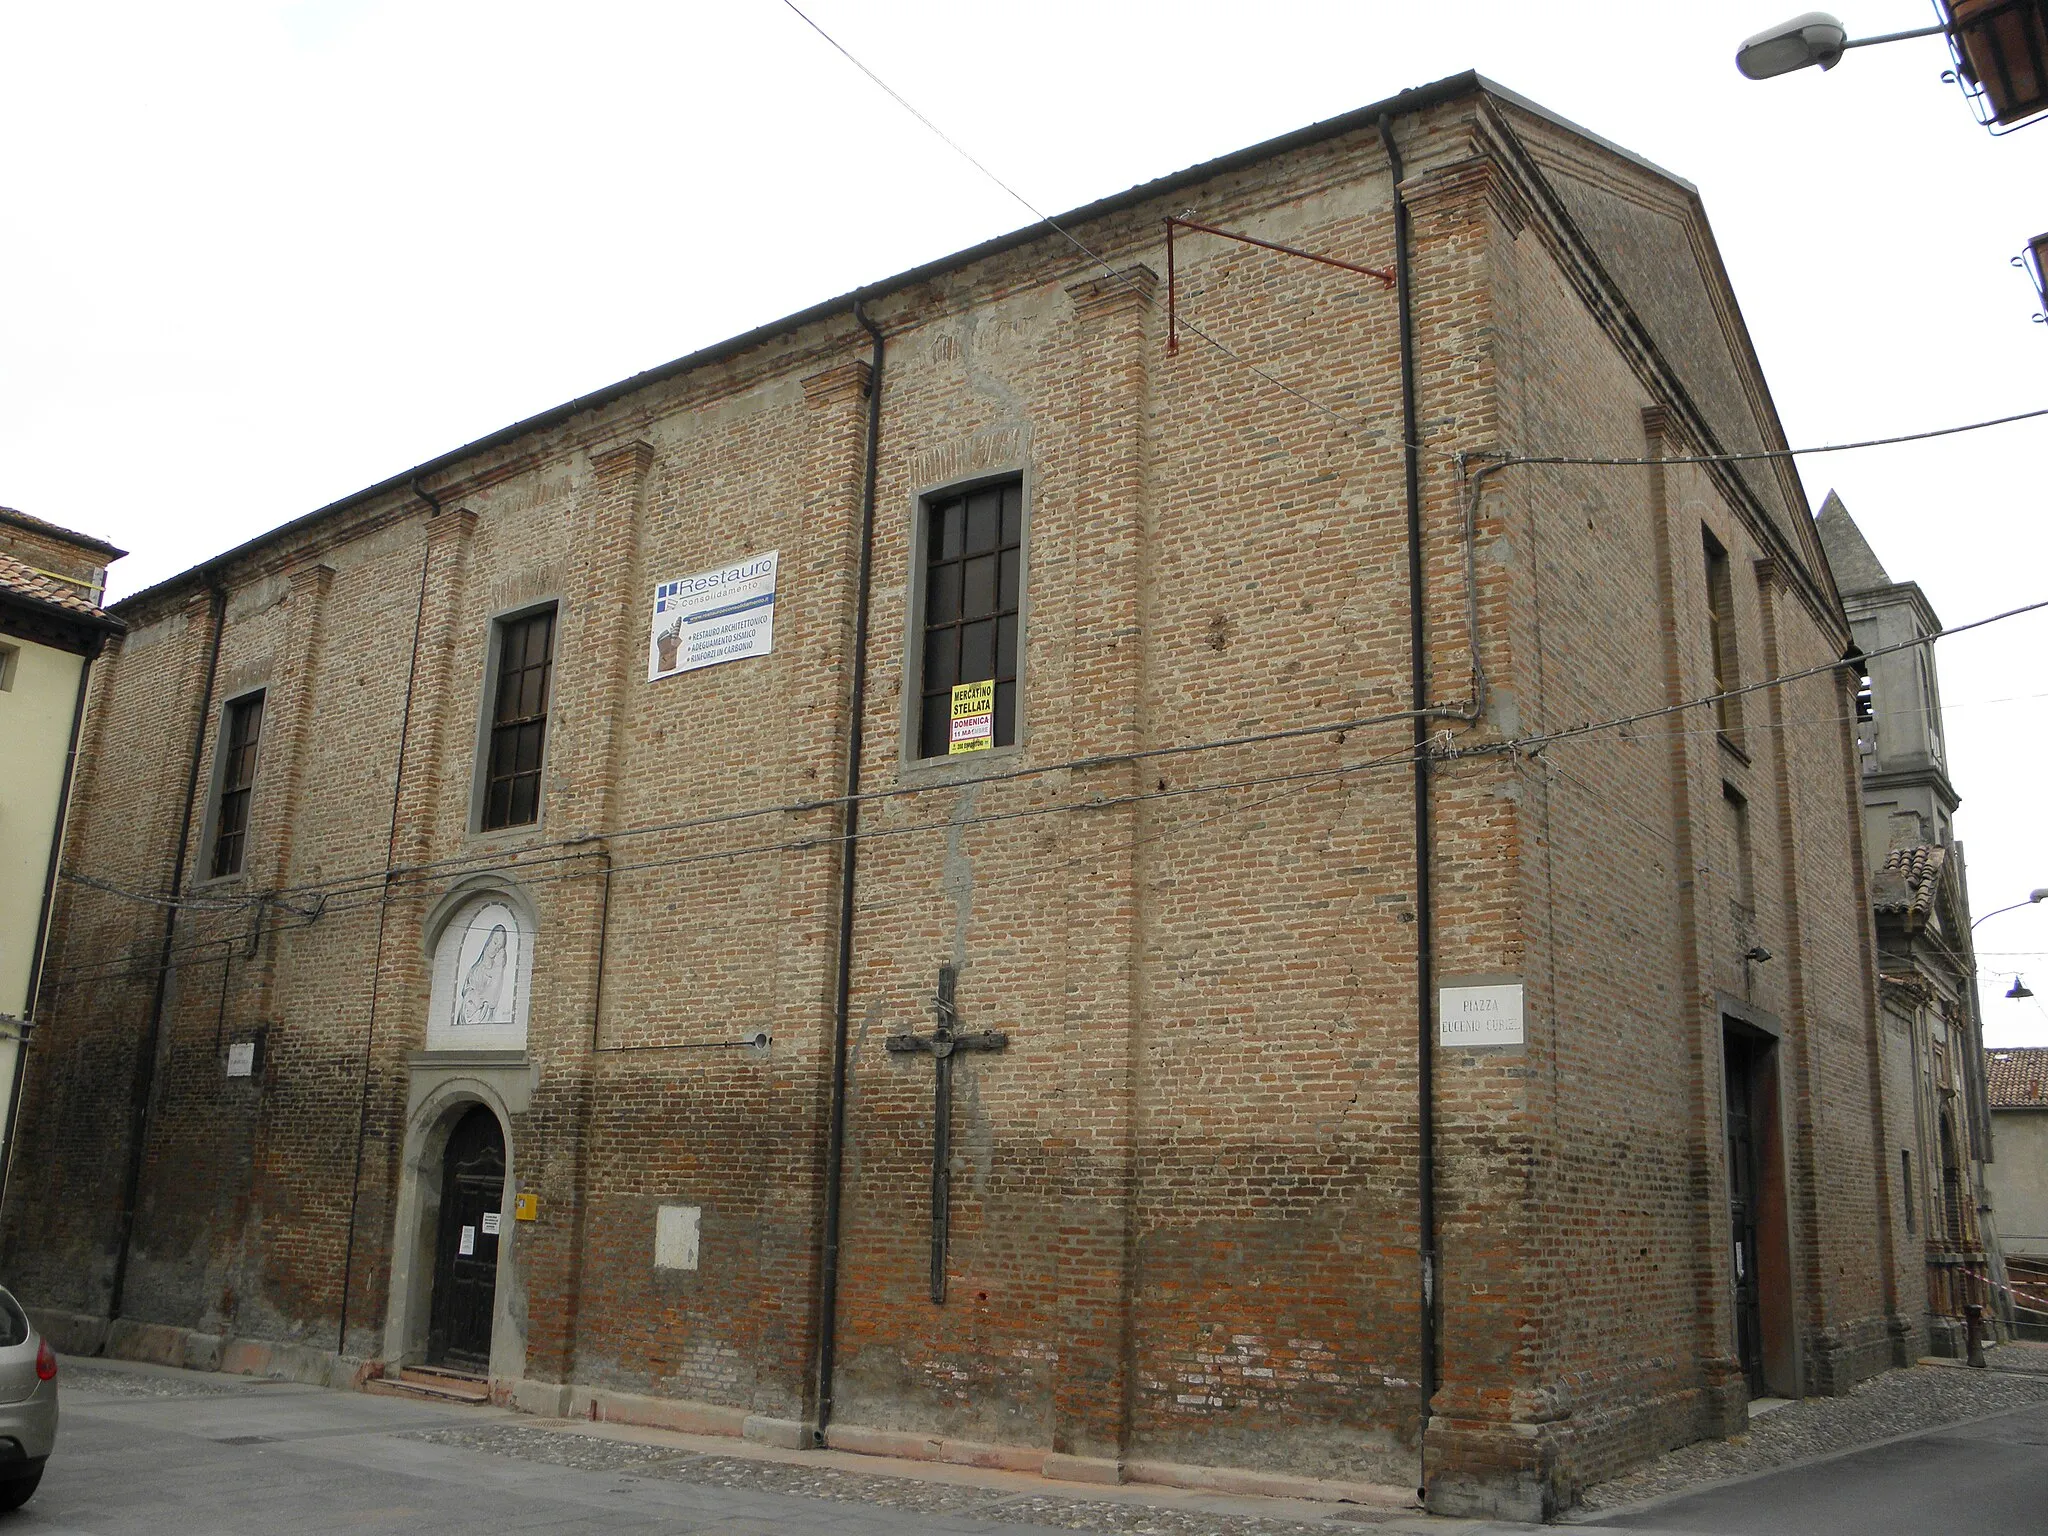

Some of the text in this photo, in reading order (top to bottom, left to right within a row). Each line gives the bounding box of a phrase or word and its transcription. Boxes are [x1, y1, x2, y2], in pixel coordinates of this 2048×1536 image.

[680, 560, 771, 595] Restauro
[681, 582, 758, 608] Consolidamento
[693, 615, 768, 641] RESTAURO ARCHITETTONICO
[691, 649, 716, 663] RINFORZI
[724, 640, 753, 655] CARBONIO
[692, 629, 756, 652] ADEGUAMENTO SISMICO
[954, 686, 991, 701] MERCATINO
[954, 700, 990, 715] STELLATA
[954, 717, 989, 729] DOMENICA
[1463, 999, 1499, 1012] PIAZZA
